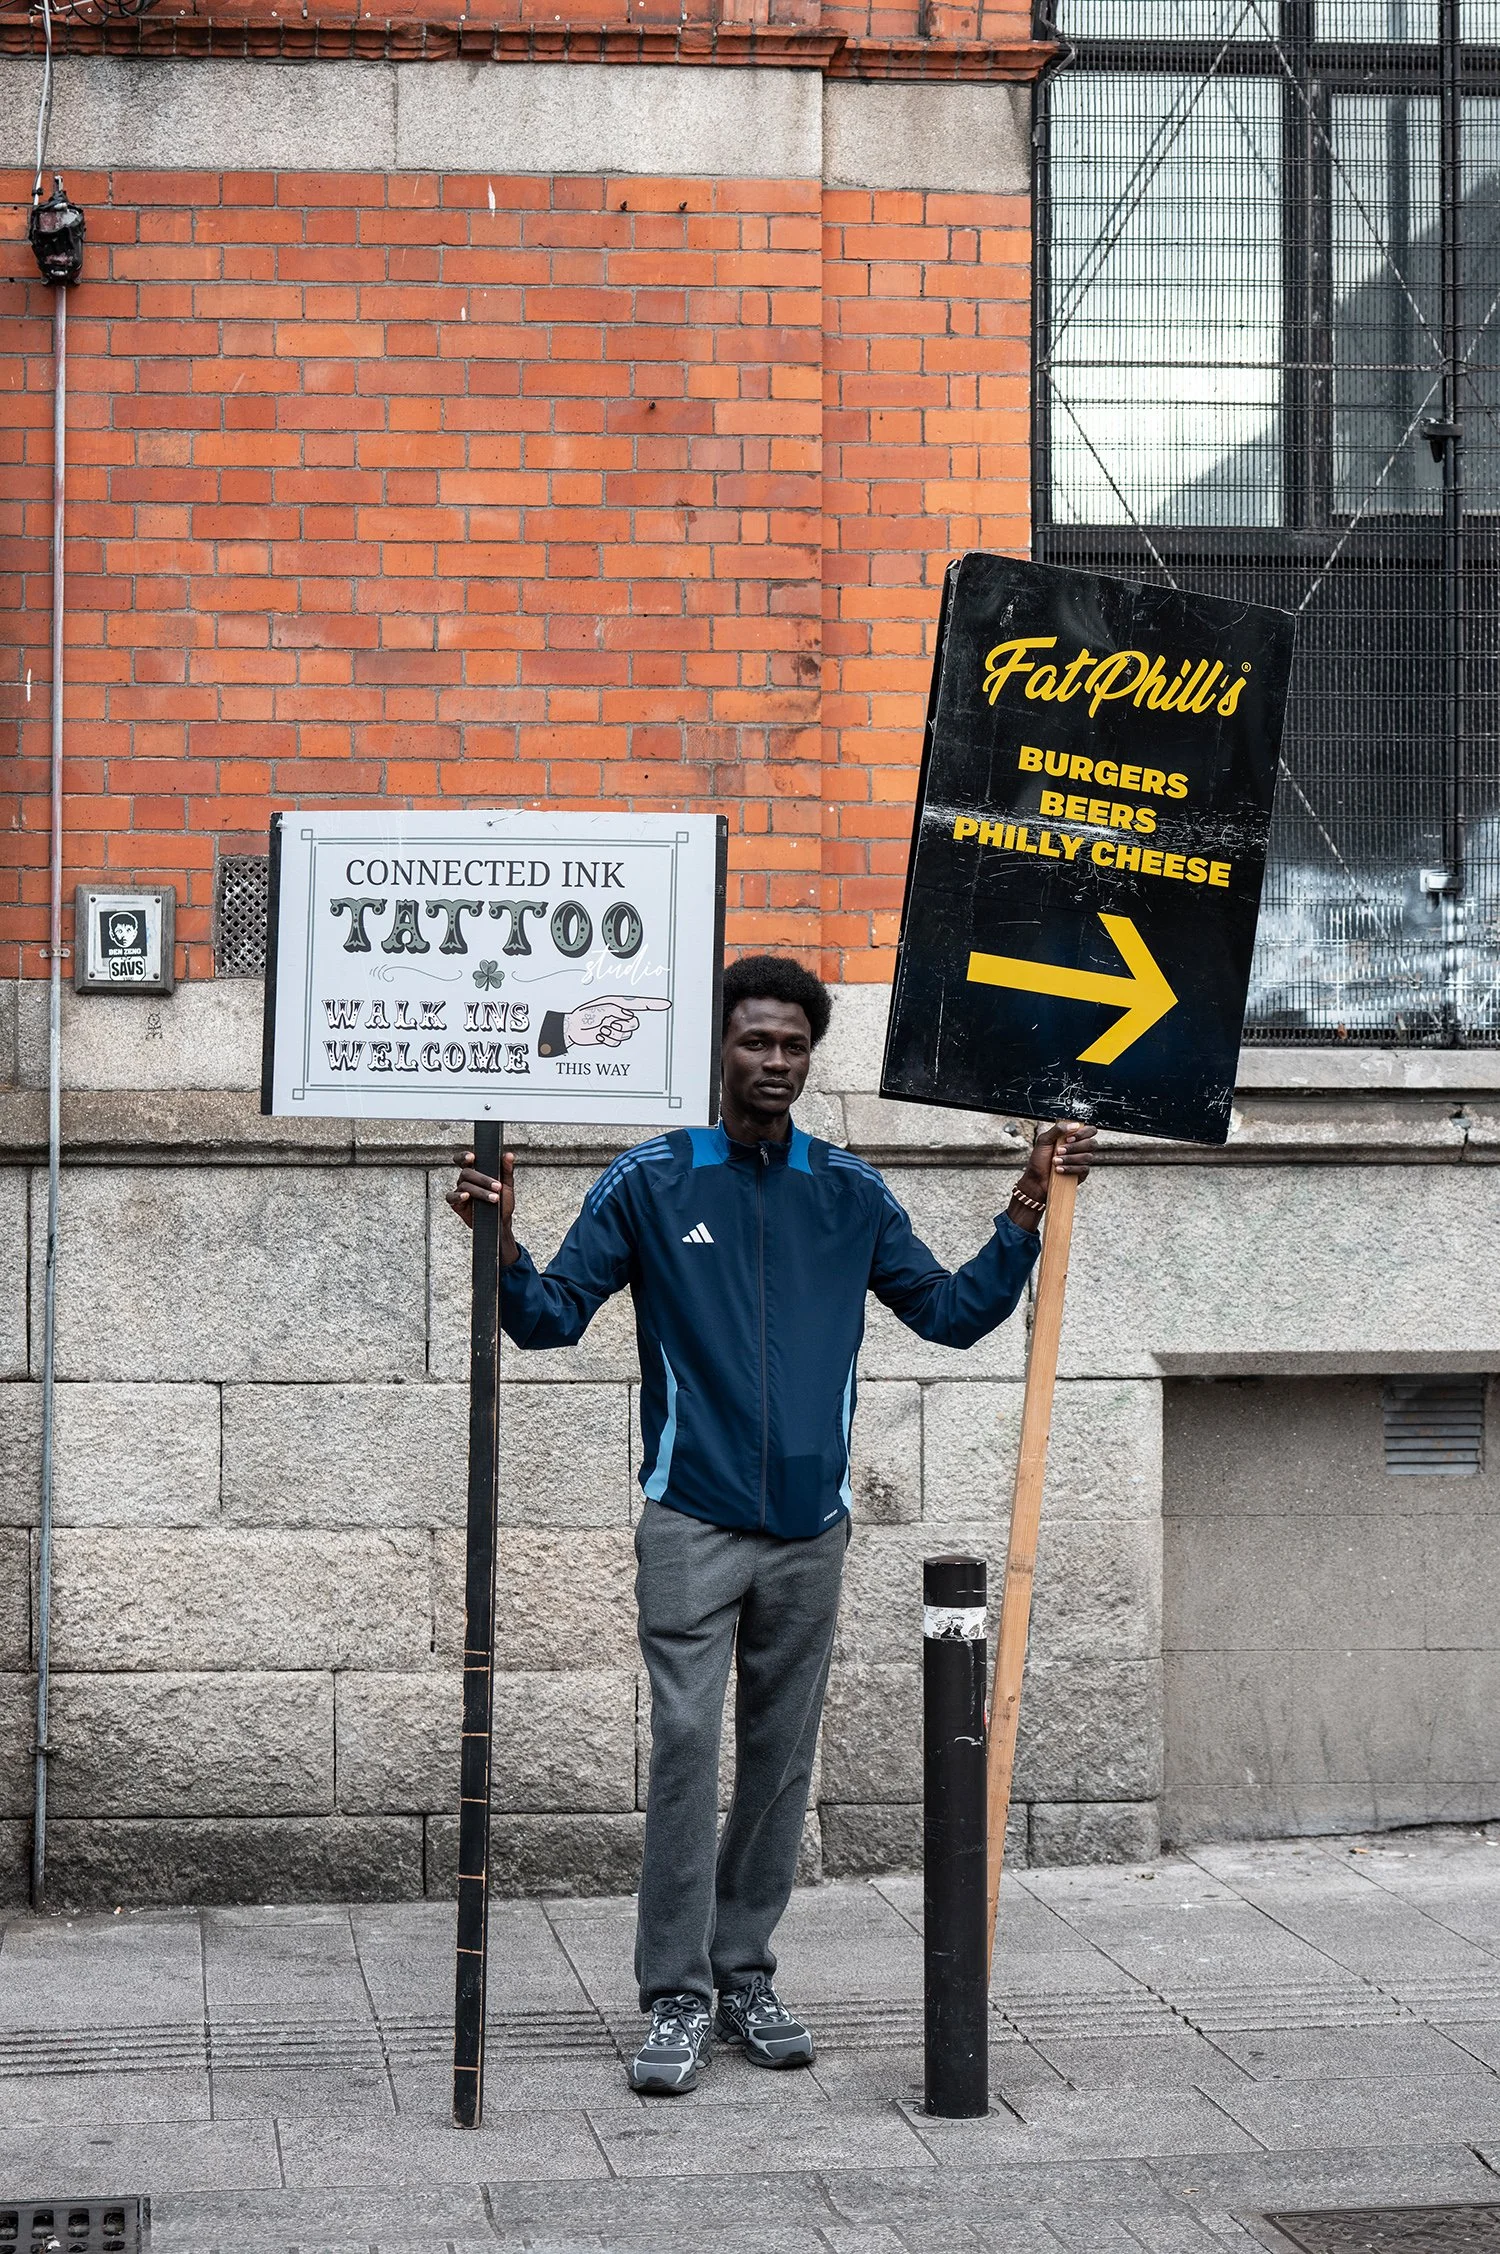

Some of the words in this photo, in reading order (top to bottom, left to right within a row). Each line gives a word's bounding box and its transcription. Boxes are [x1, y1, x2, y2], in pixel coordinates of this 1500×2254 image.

[1018, 745, 1189, 799] BURGERS
[1039, 789, 1157, 835] BEERS
[952, 815, 1084, 861] PHILLY
[1090, 840, 1232, 888] CHEESE
[345, 859, 551, 887] CONNECTED
[561, 861, 626, 889] INK
[329, 896, 644, 960] TATTOO
[112, 961, 143, 976] SAVS
[581, 943, 671, 985] studio
[322, 999, 447, 1031] WALK
[463, 1001, 531, 1032] INS
[322, 1039, 531, 1075] WELCOME
[555, 1062, 592, 1076] THIS
[595, 1063, 631, 1077] WAY
